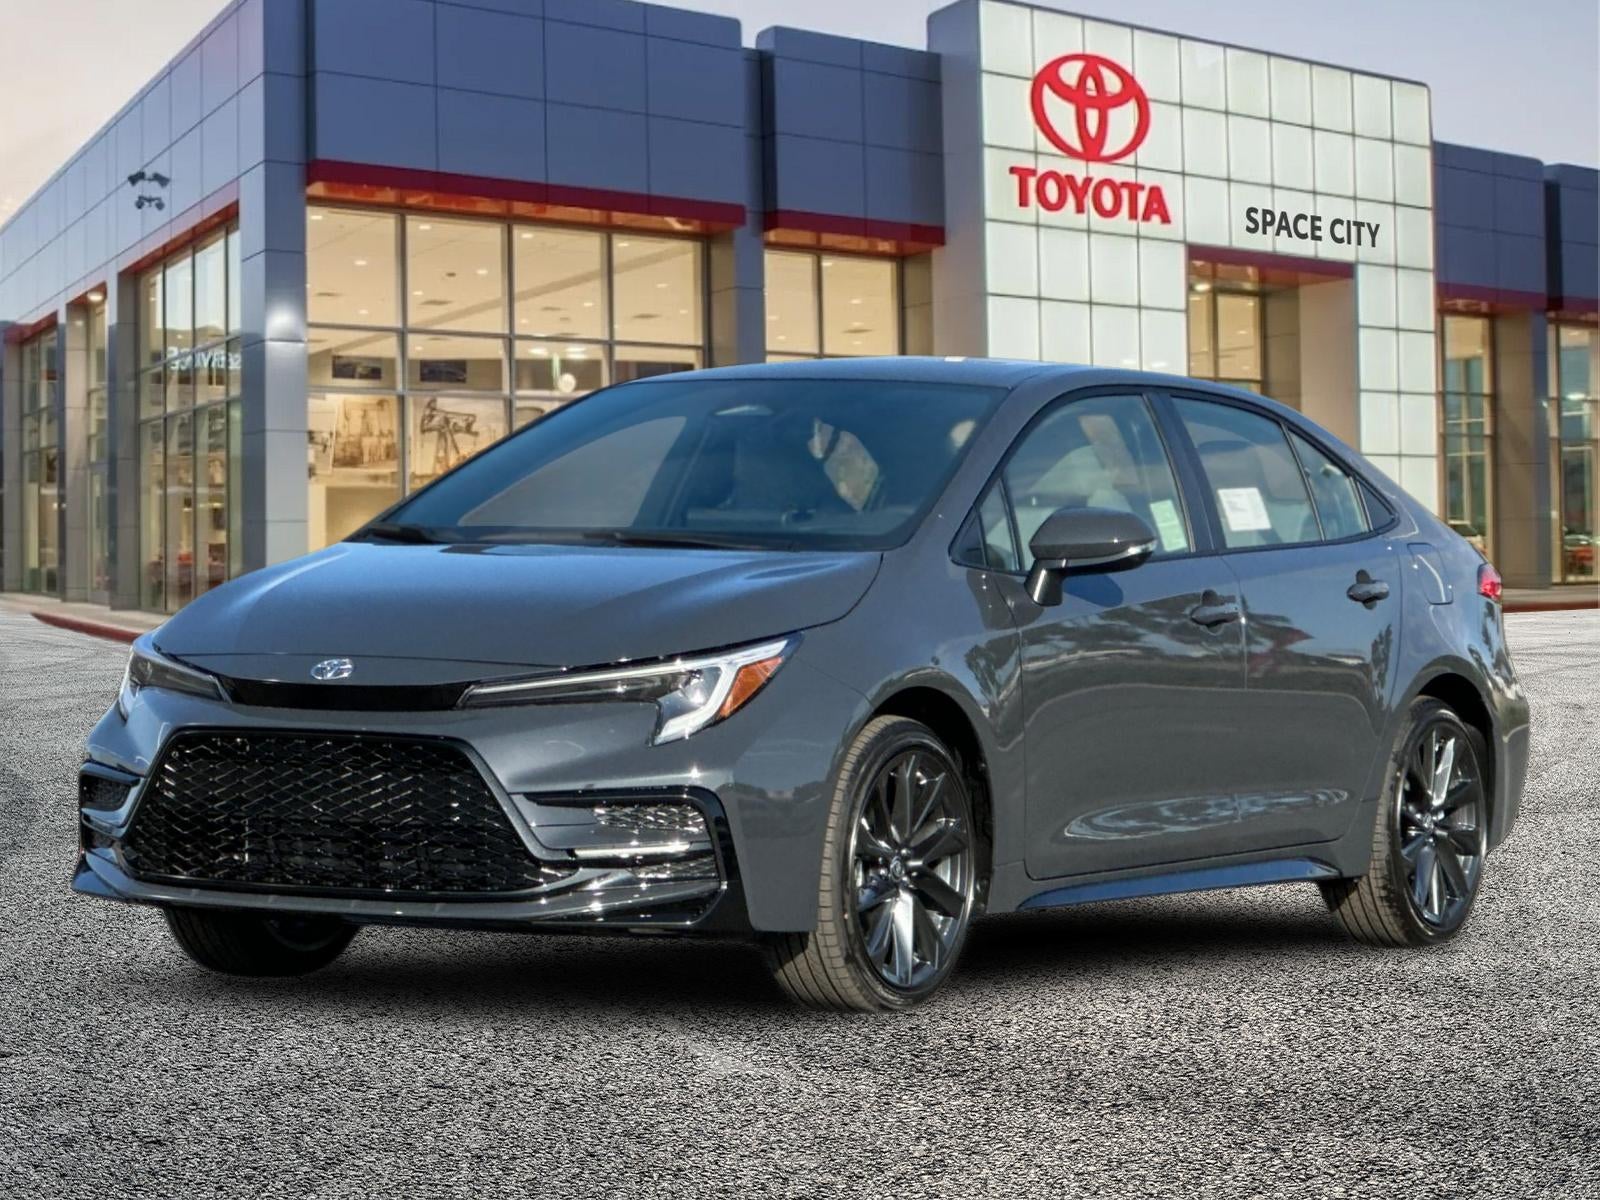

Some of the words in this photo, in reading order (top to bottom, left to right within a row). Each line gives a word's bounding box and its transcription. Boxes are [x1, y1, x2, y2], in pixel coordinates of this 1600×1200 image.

[1009, 166, 1172, 224] TOYOTA
[1245, 206, 1323, 242] SPACE
[1329, 217, 1381, 248] CITY
